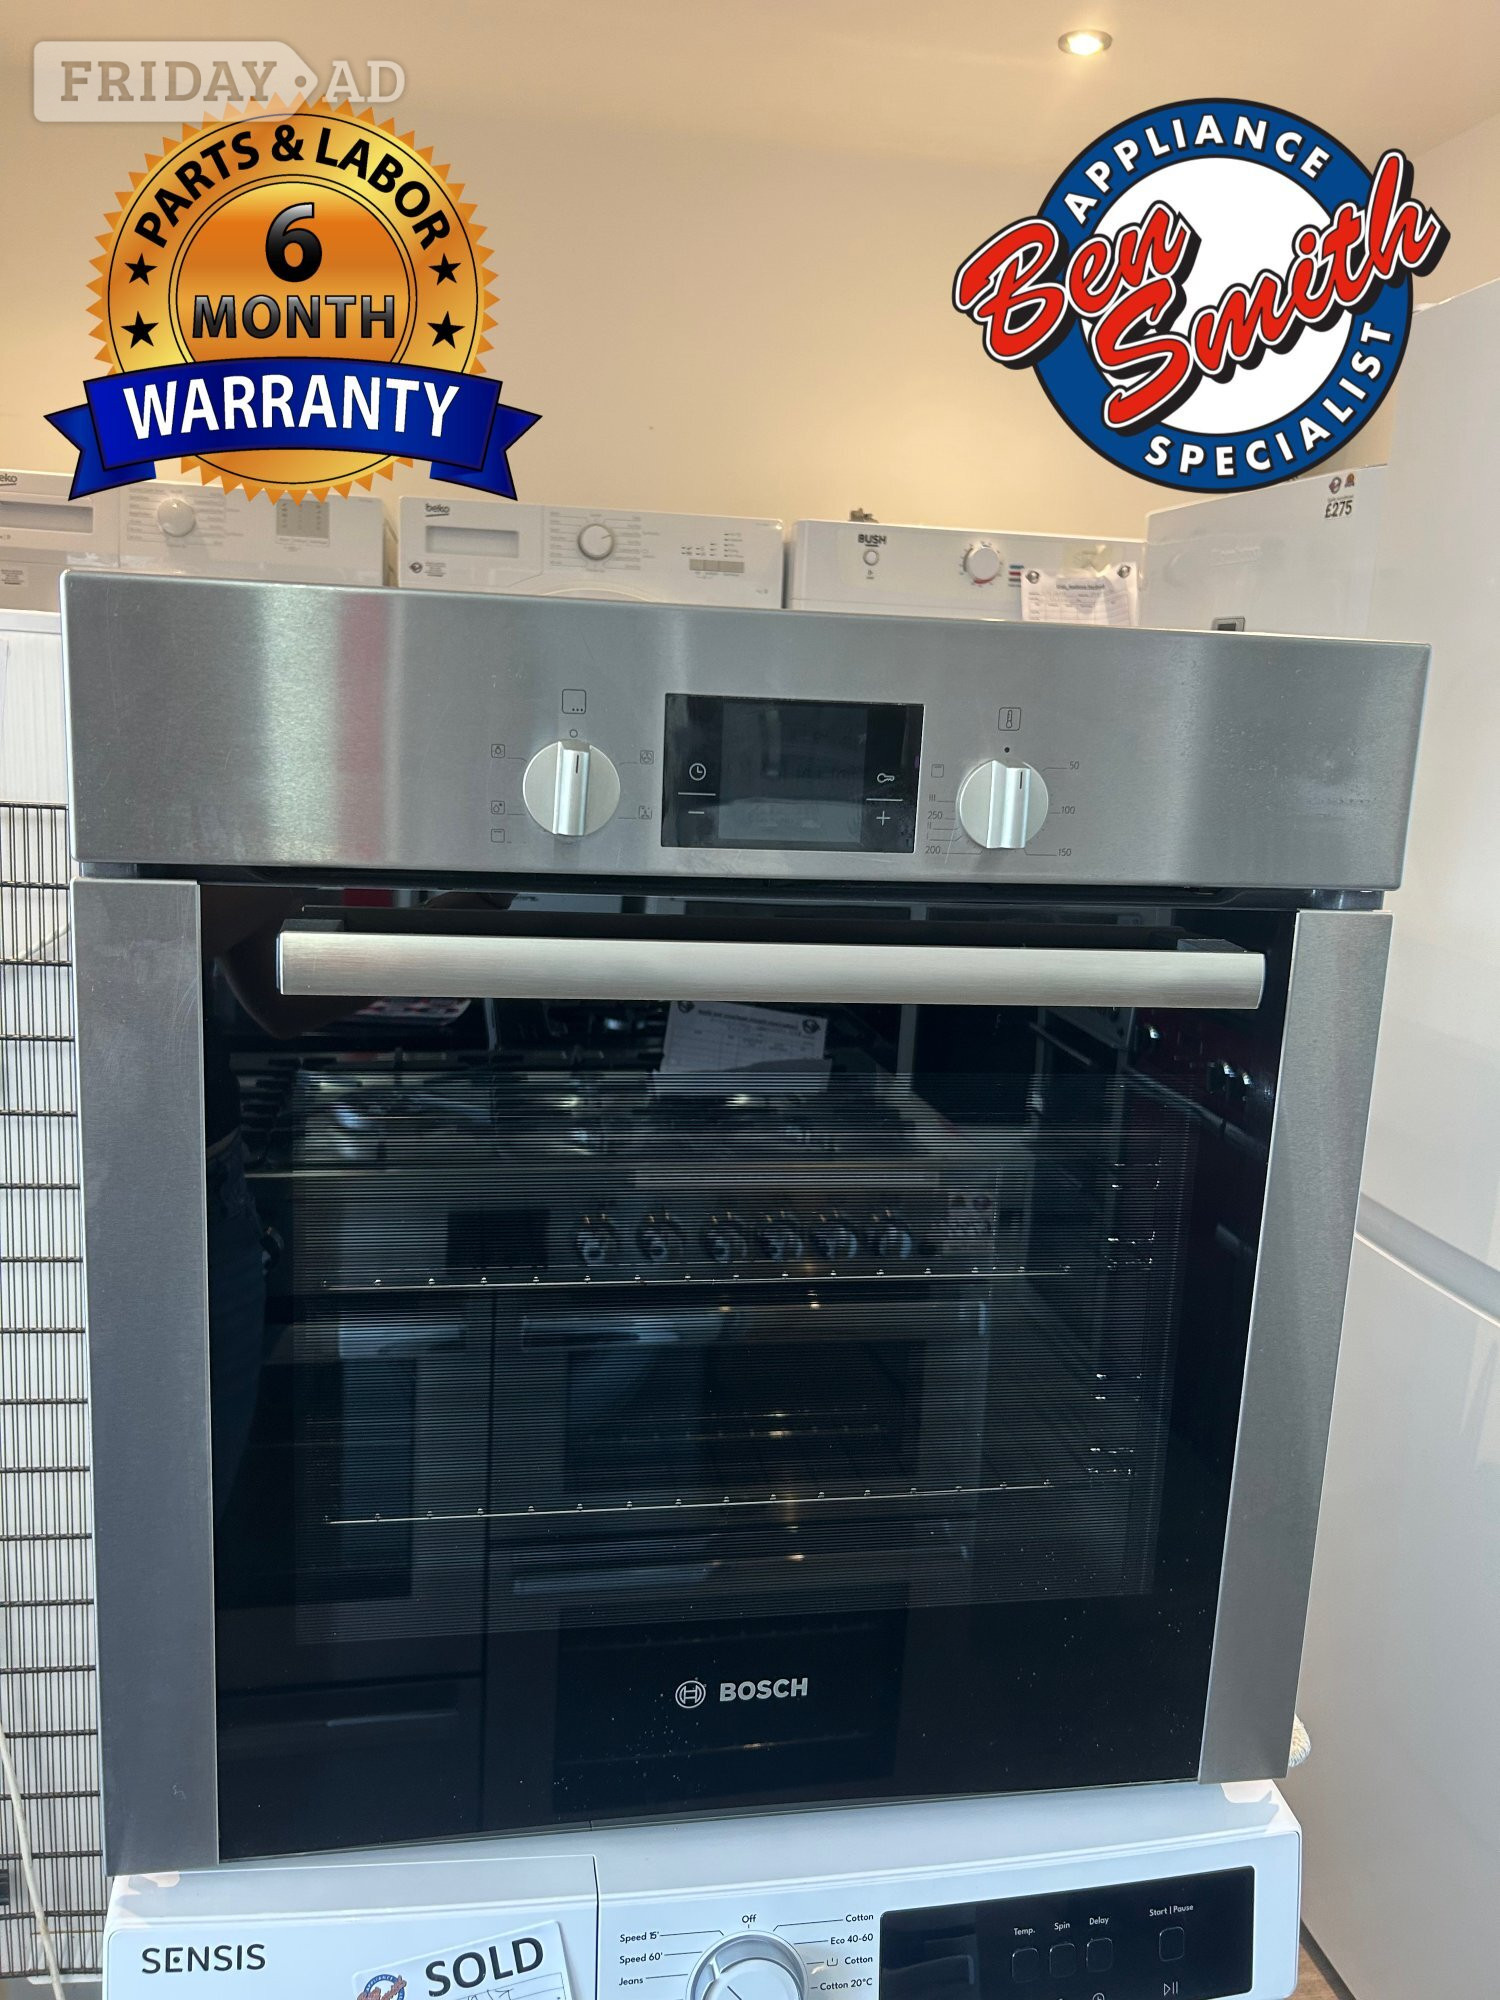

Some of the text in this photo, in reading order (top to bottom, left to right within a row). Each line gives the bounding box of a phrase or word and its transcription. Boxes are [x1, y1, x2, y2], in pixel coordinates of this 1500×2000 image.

[0, 474, 18, 483] eko
[1325, 500, 1353, 518] £275
[857, 533, 887, 545] BUSH
[1069, 761, 1079, 769] 50
[927, 811, 943, 820] 250
[1061, 806, 1076, 815] 100
[925, 846, 941, 855] 200
[1058, 848, 1072, 857] 150
[719, 1677, 808, 1702] BOSCH
[1149, 1903, 1194, 1917] Start Pause
[741, 1914, 757, 1924] Off
[845, 1914, 874, 1923] Cotton
[1089, 1916, 1109, 1926] Delay
[1054, 1921, 1071, 1932] Spin
[1013, 1927, 1036, 1937] Temp.
[620, 1932, 647, 1944] Speed
[830, 1933, 874, 1945] Eco 40-60
[141, 1943, 267, 1974] SENSIS
[619, 1953, 647, 1965] Speed
[844, 1956, 873, 1965] Cotton
[425, 1937, 544, 1998] SOLD
[619, 1976, 644, 1986] Jeans
[820, 1978, 873, 1991] Cotton 20°C
